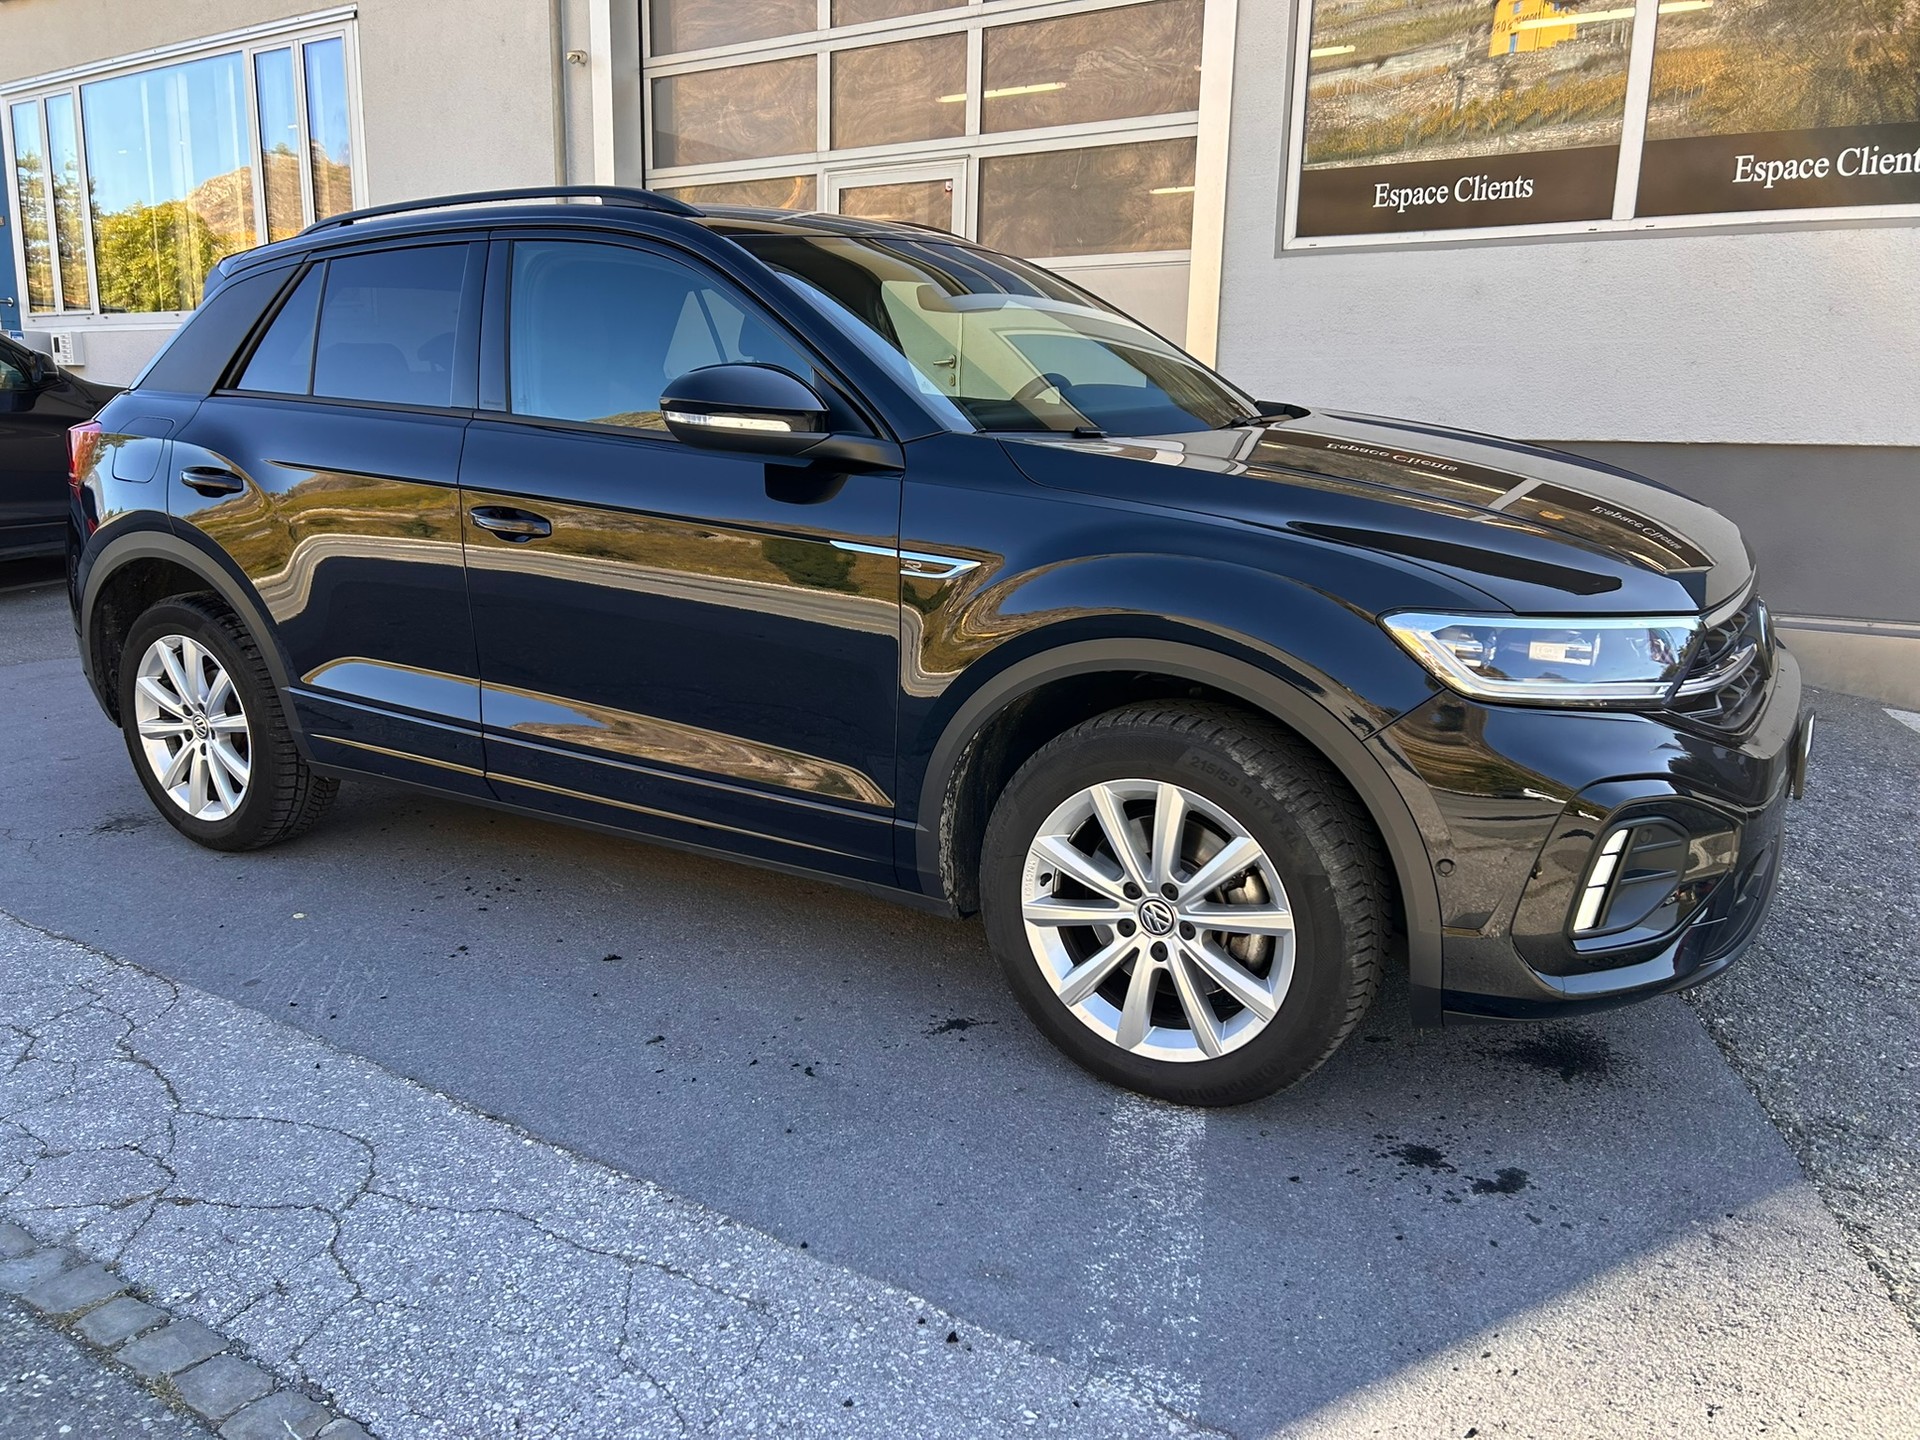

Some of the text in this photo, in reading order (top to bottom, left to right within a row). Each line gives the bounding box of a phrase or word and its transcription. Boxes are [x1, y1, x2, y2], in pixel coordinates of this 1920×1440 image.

[1732, 155, 1829, 189] Espace
[1373, 175, 1534, 213] Espace Clients
[1190, 756, 1239, 788] 215/55
[1240, 784, 1253, 797] R
